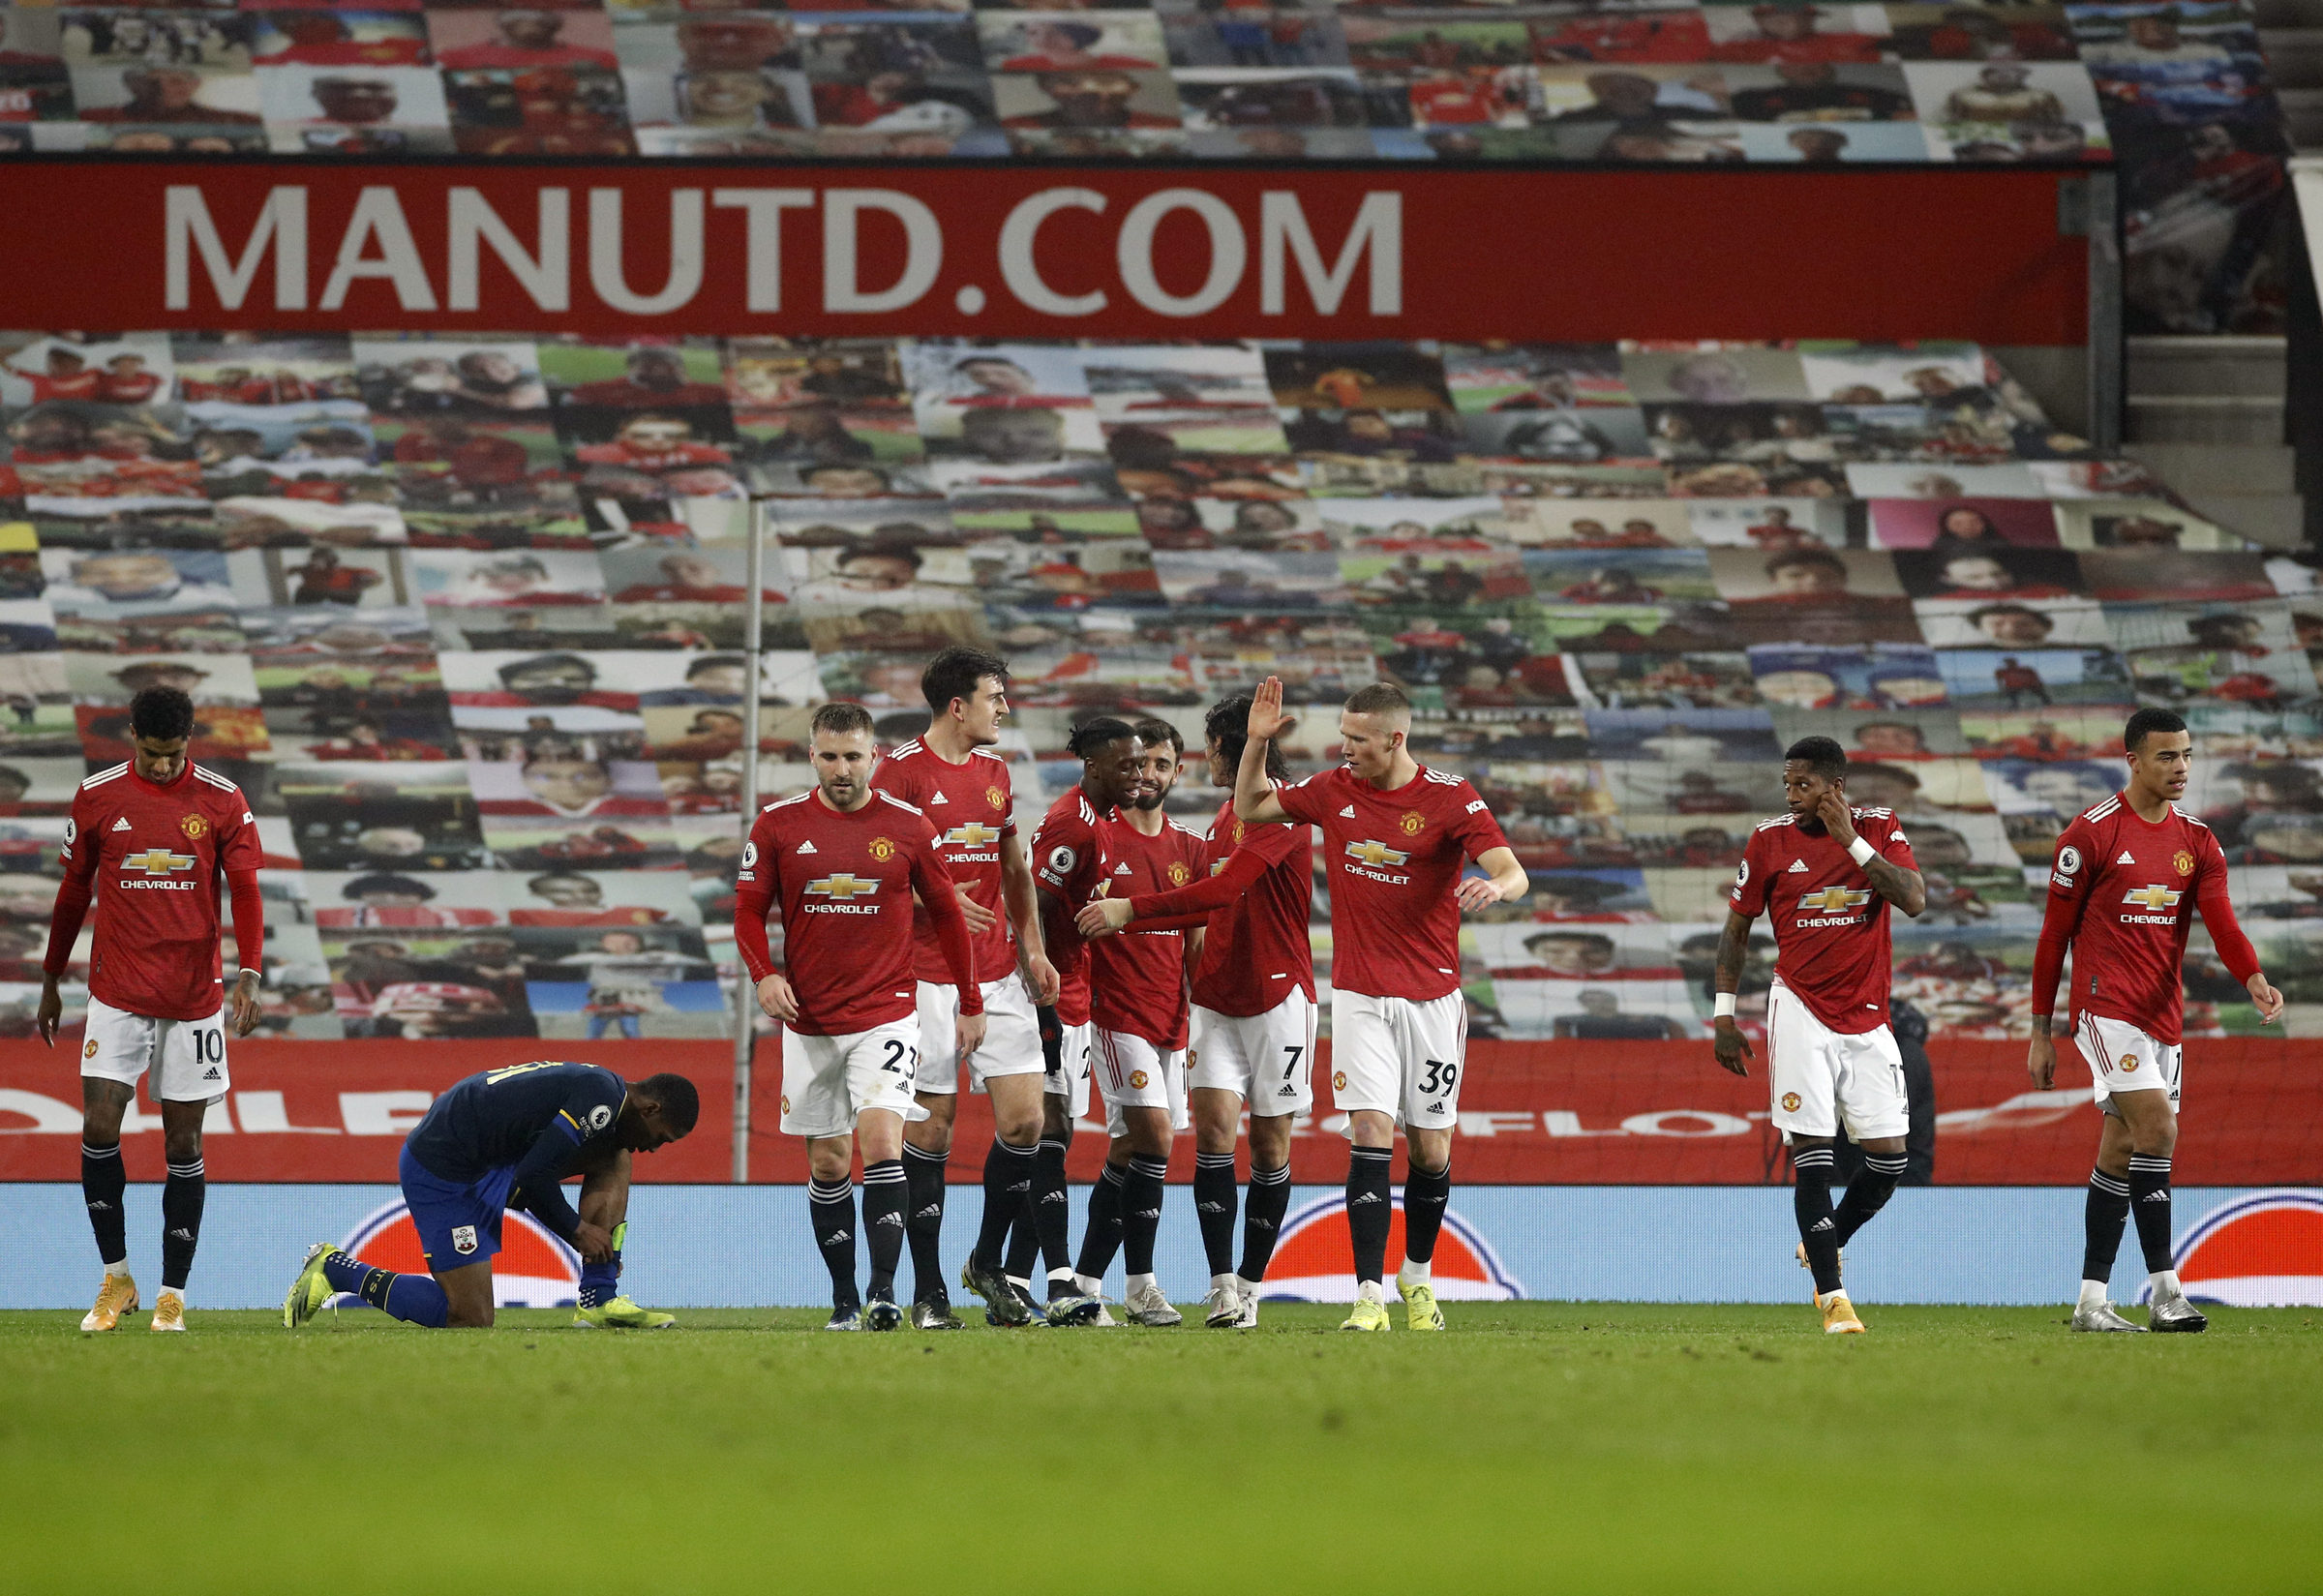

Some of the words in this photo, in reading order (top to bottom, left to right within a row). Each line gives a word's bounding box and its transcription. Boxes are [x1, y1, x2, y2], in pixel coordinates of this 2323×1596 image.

[165, 185, 1403, 317] MANUTD.COM
[120, 880, 197, 890] CHEVROLET
[804, 904, 881, 915] CHEVROLET
[1796, 914, 1868, 928] CHEVROLET
[2120, 914, 2177, 925] CHEVROLE
[193, 1029, 224, 1064] 10
[881, 1039, 917, 1080] 23
[1283, 1046, 1304, 1080] 7
[1418, 1059, 1457, 1099] 39
